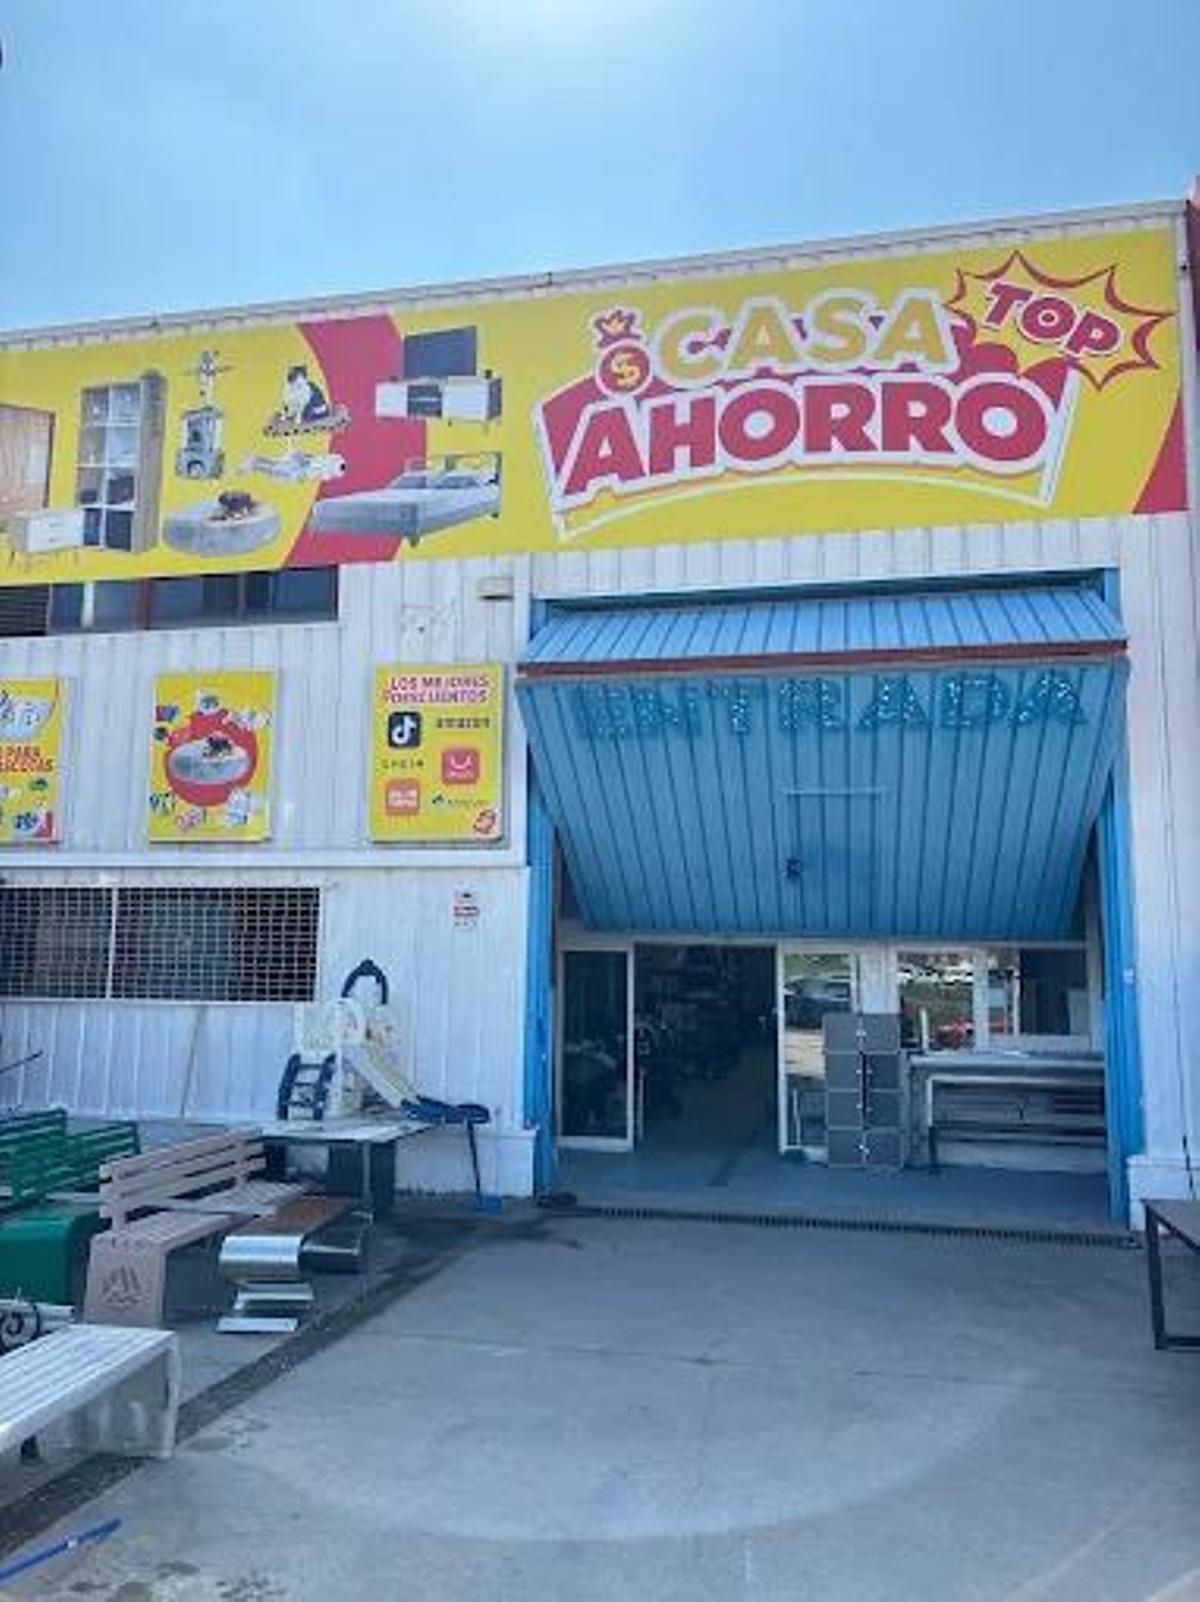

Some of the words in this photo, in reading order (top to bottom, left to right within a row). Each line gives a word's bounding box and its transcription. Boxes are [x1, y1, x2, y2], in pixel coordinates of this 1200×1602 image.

[658, 292, 950, 382] CASA
[985, 283, 1120, 355] TOP
[563, 378, 1048, 494] AHORRO
[391, 676, 418, 691] LOS
